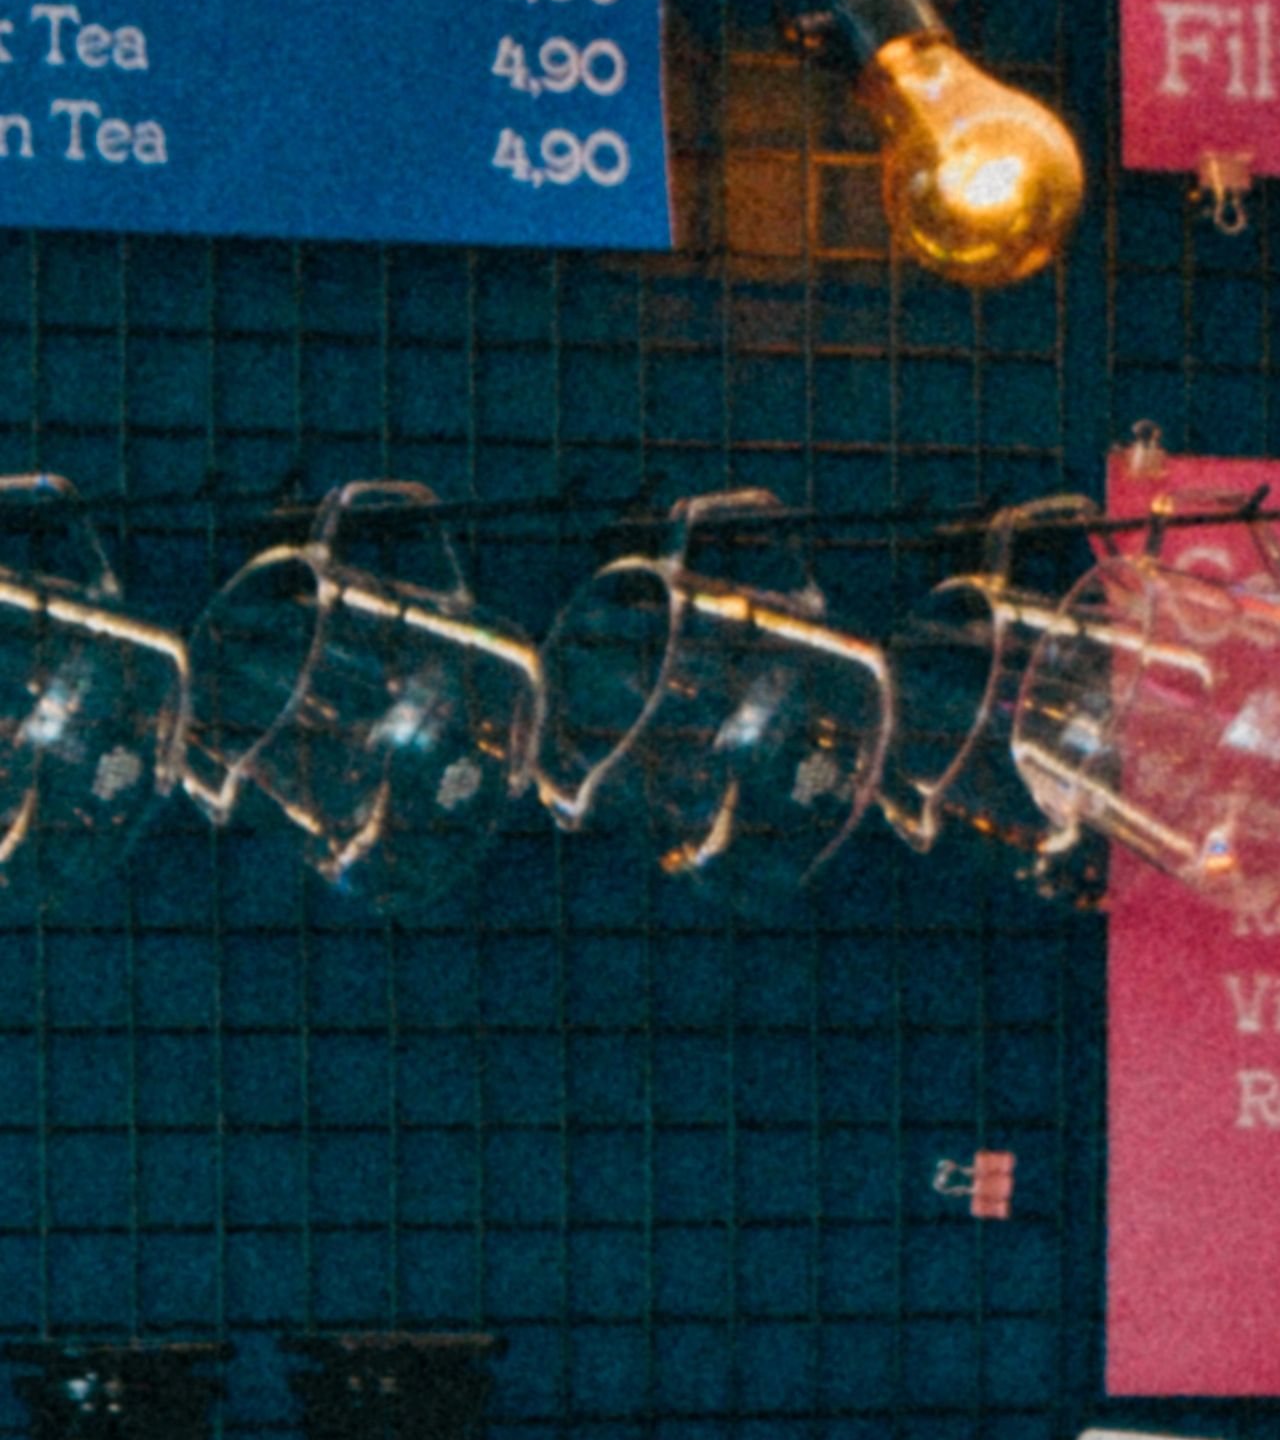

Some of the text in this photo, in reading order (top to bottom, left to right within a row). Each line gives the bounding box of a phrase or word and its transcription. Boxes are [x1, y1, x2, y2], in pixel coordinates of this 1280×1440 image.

[31, 4, 148, 71] Tea
[491, 36, 628, 98] 4,90
[51, 98, 169, 164] Tea
[492, 128, 631, 188] 4,90
